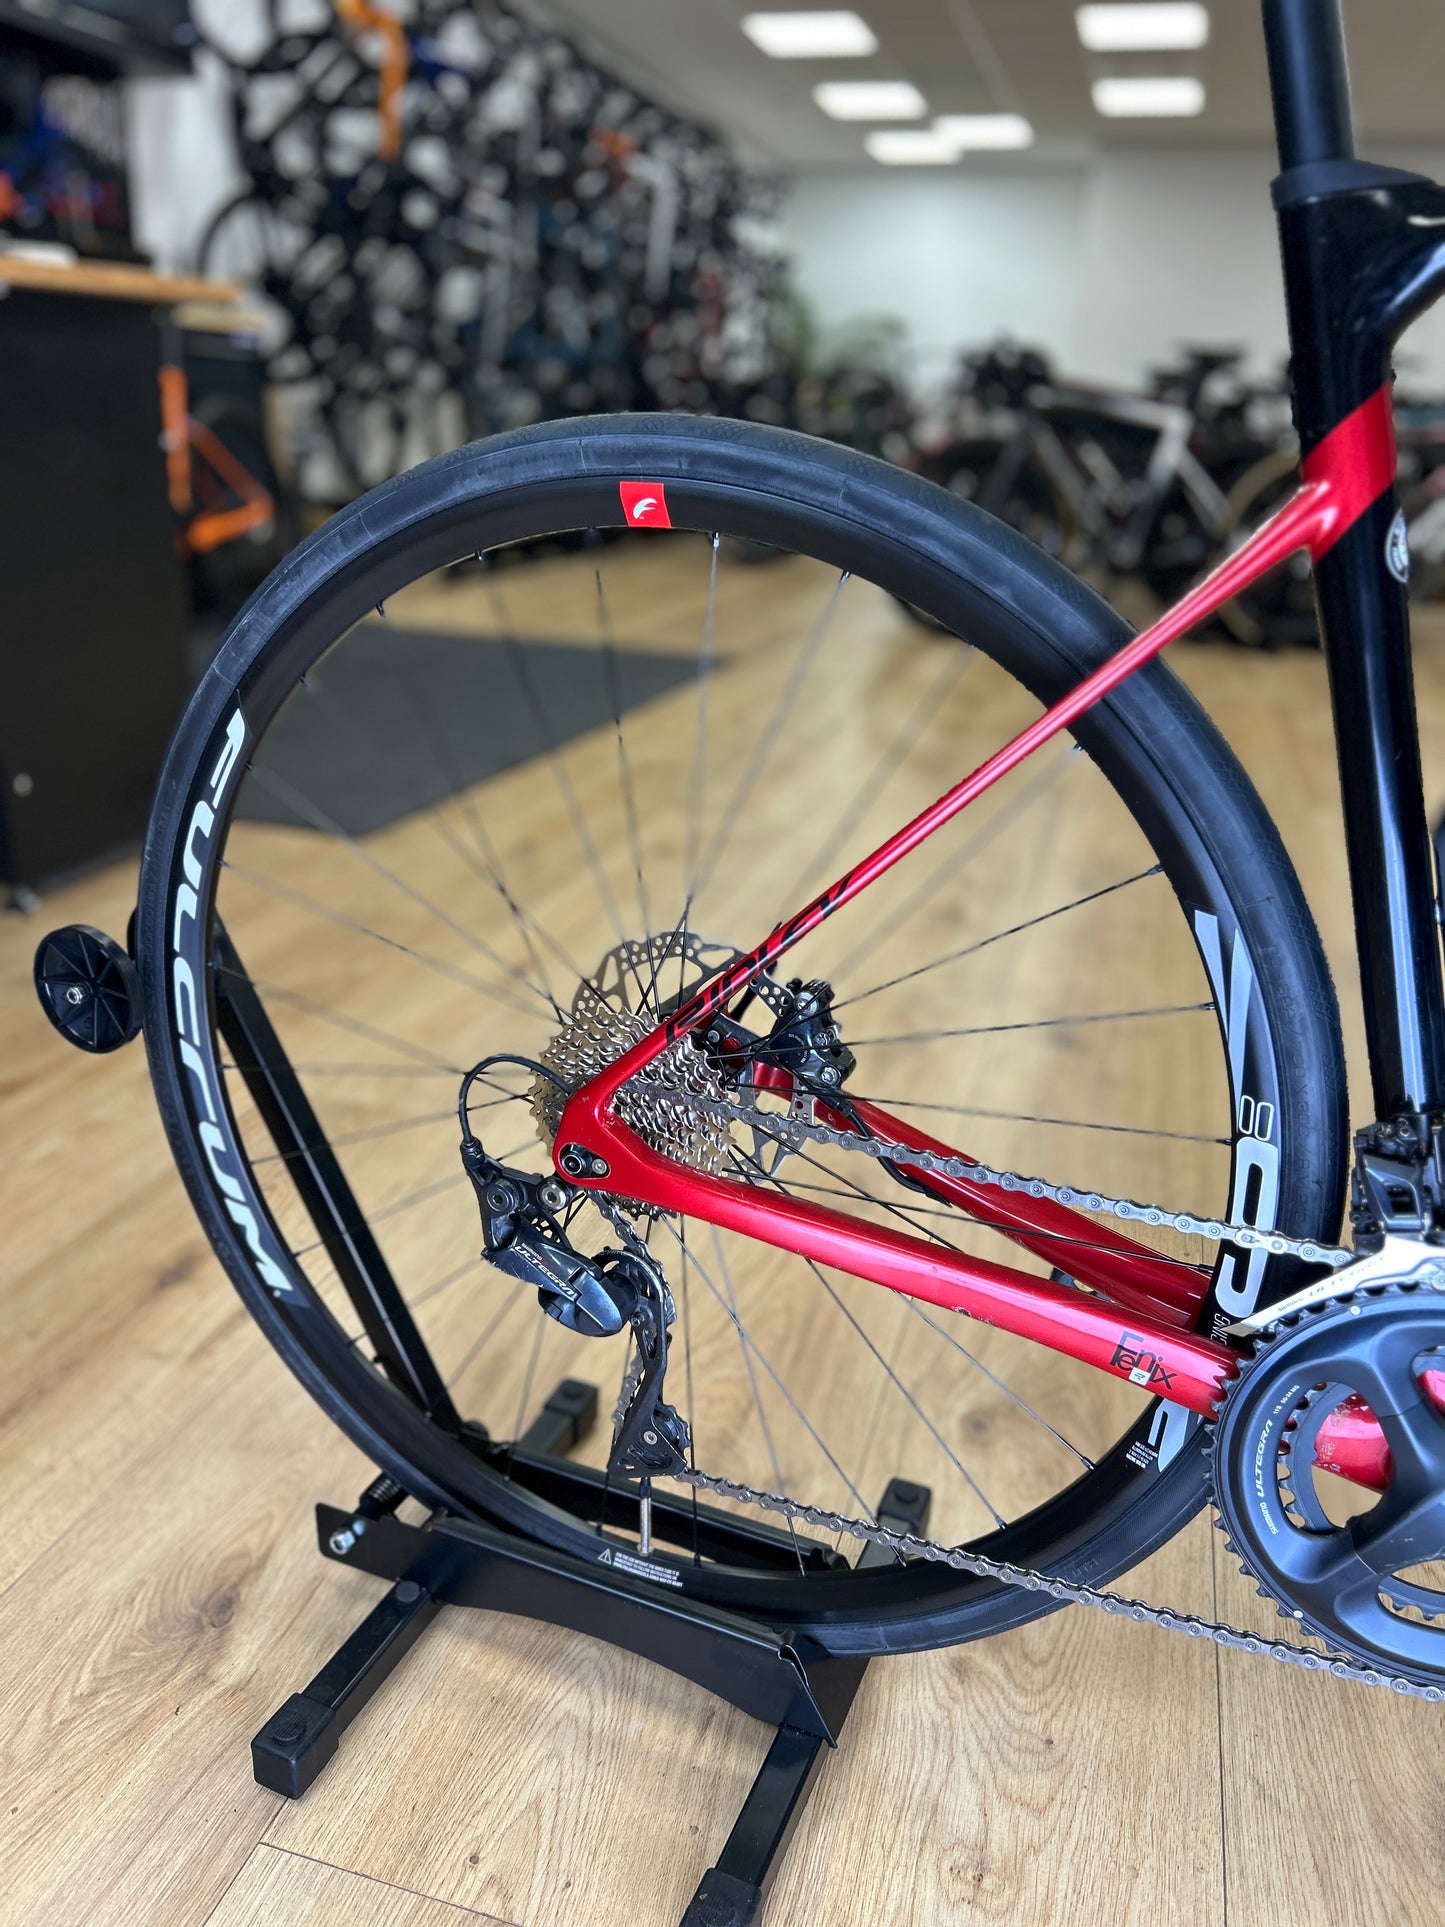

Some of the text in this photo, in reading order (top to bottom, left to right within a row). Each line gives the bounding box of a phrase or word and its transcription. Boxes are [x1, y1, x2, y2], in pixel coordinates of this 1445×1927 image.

[173, 708, 293, 1293] FULCRUM
[514, 1246, 575, 1296] ULTEGRA
[1255, 1420, 1273, 1497] ULTEGRA
[1260, 1502, 1278, 1534] SHIMANO
